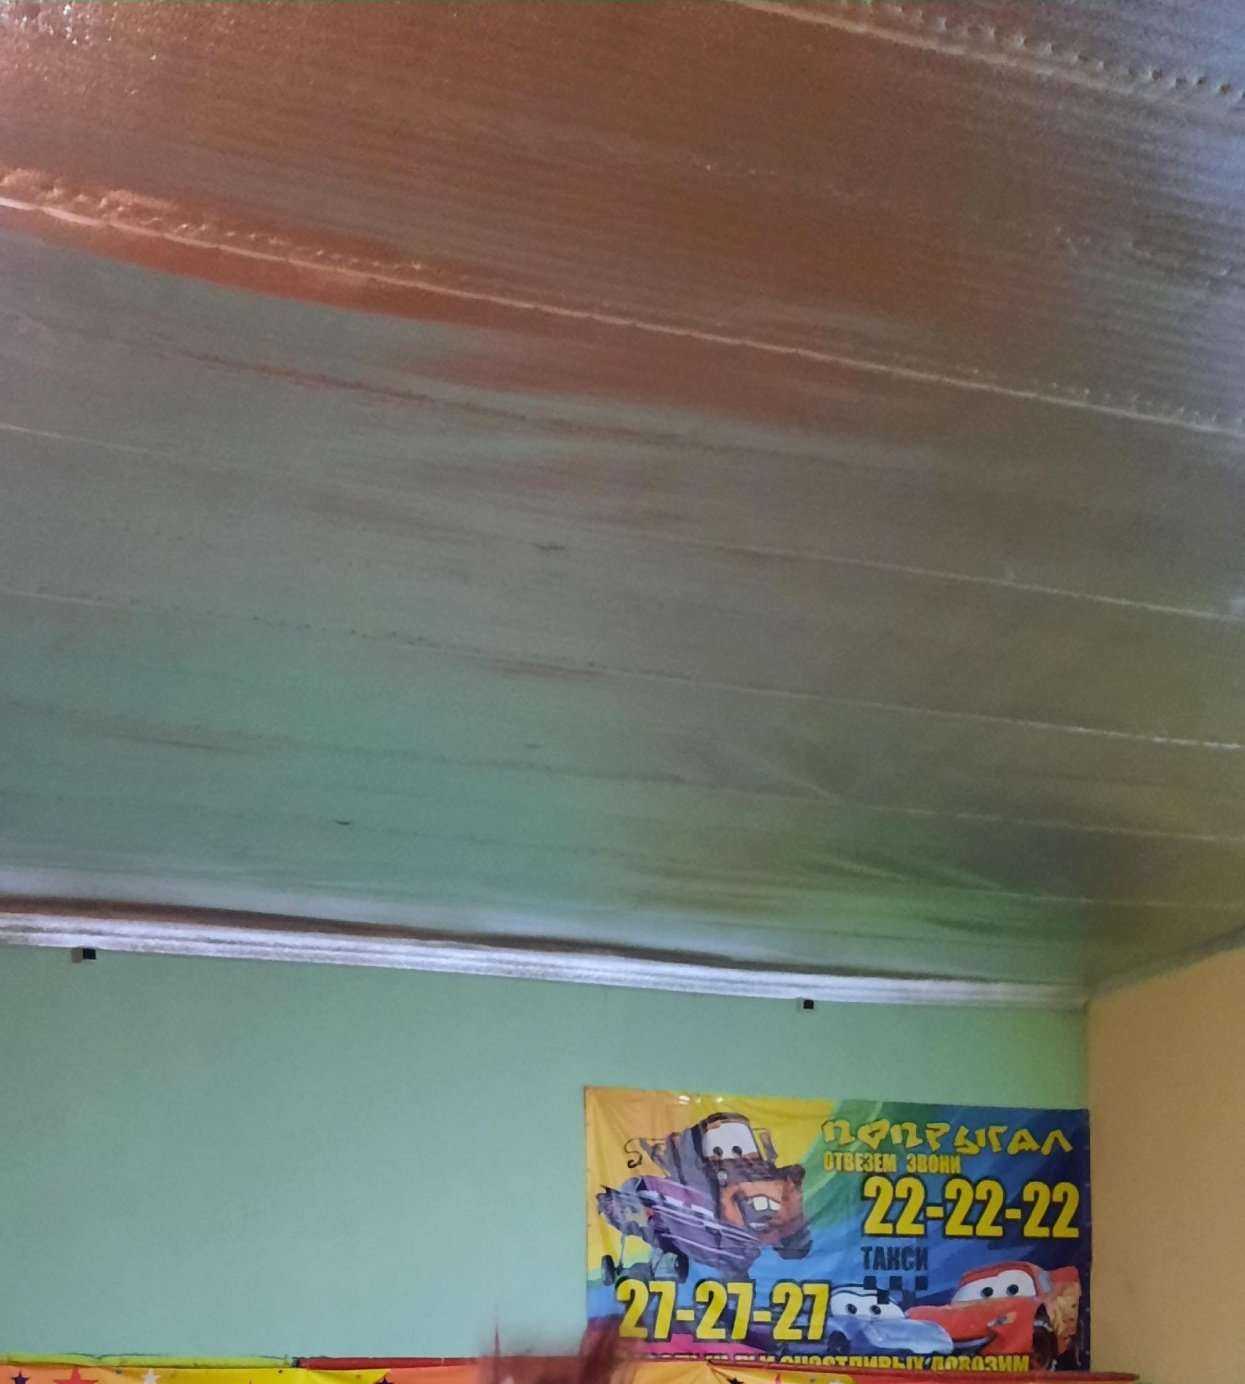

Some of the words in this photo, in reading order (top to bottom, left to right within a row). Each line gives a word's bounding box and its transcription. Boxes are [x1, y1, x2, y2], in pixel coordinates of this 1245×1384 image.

[823, 1151, 897, 1173] ОТВЕЗЕМ
[906, 1152, 961, 1175] ЗВОНИ
[861, 1175, 1081, 1239] 22-22-22
[860, 1246, 929, 1271] ТАКСИ
[614, 1279, 831, 1342] 27-27-27
